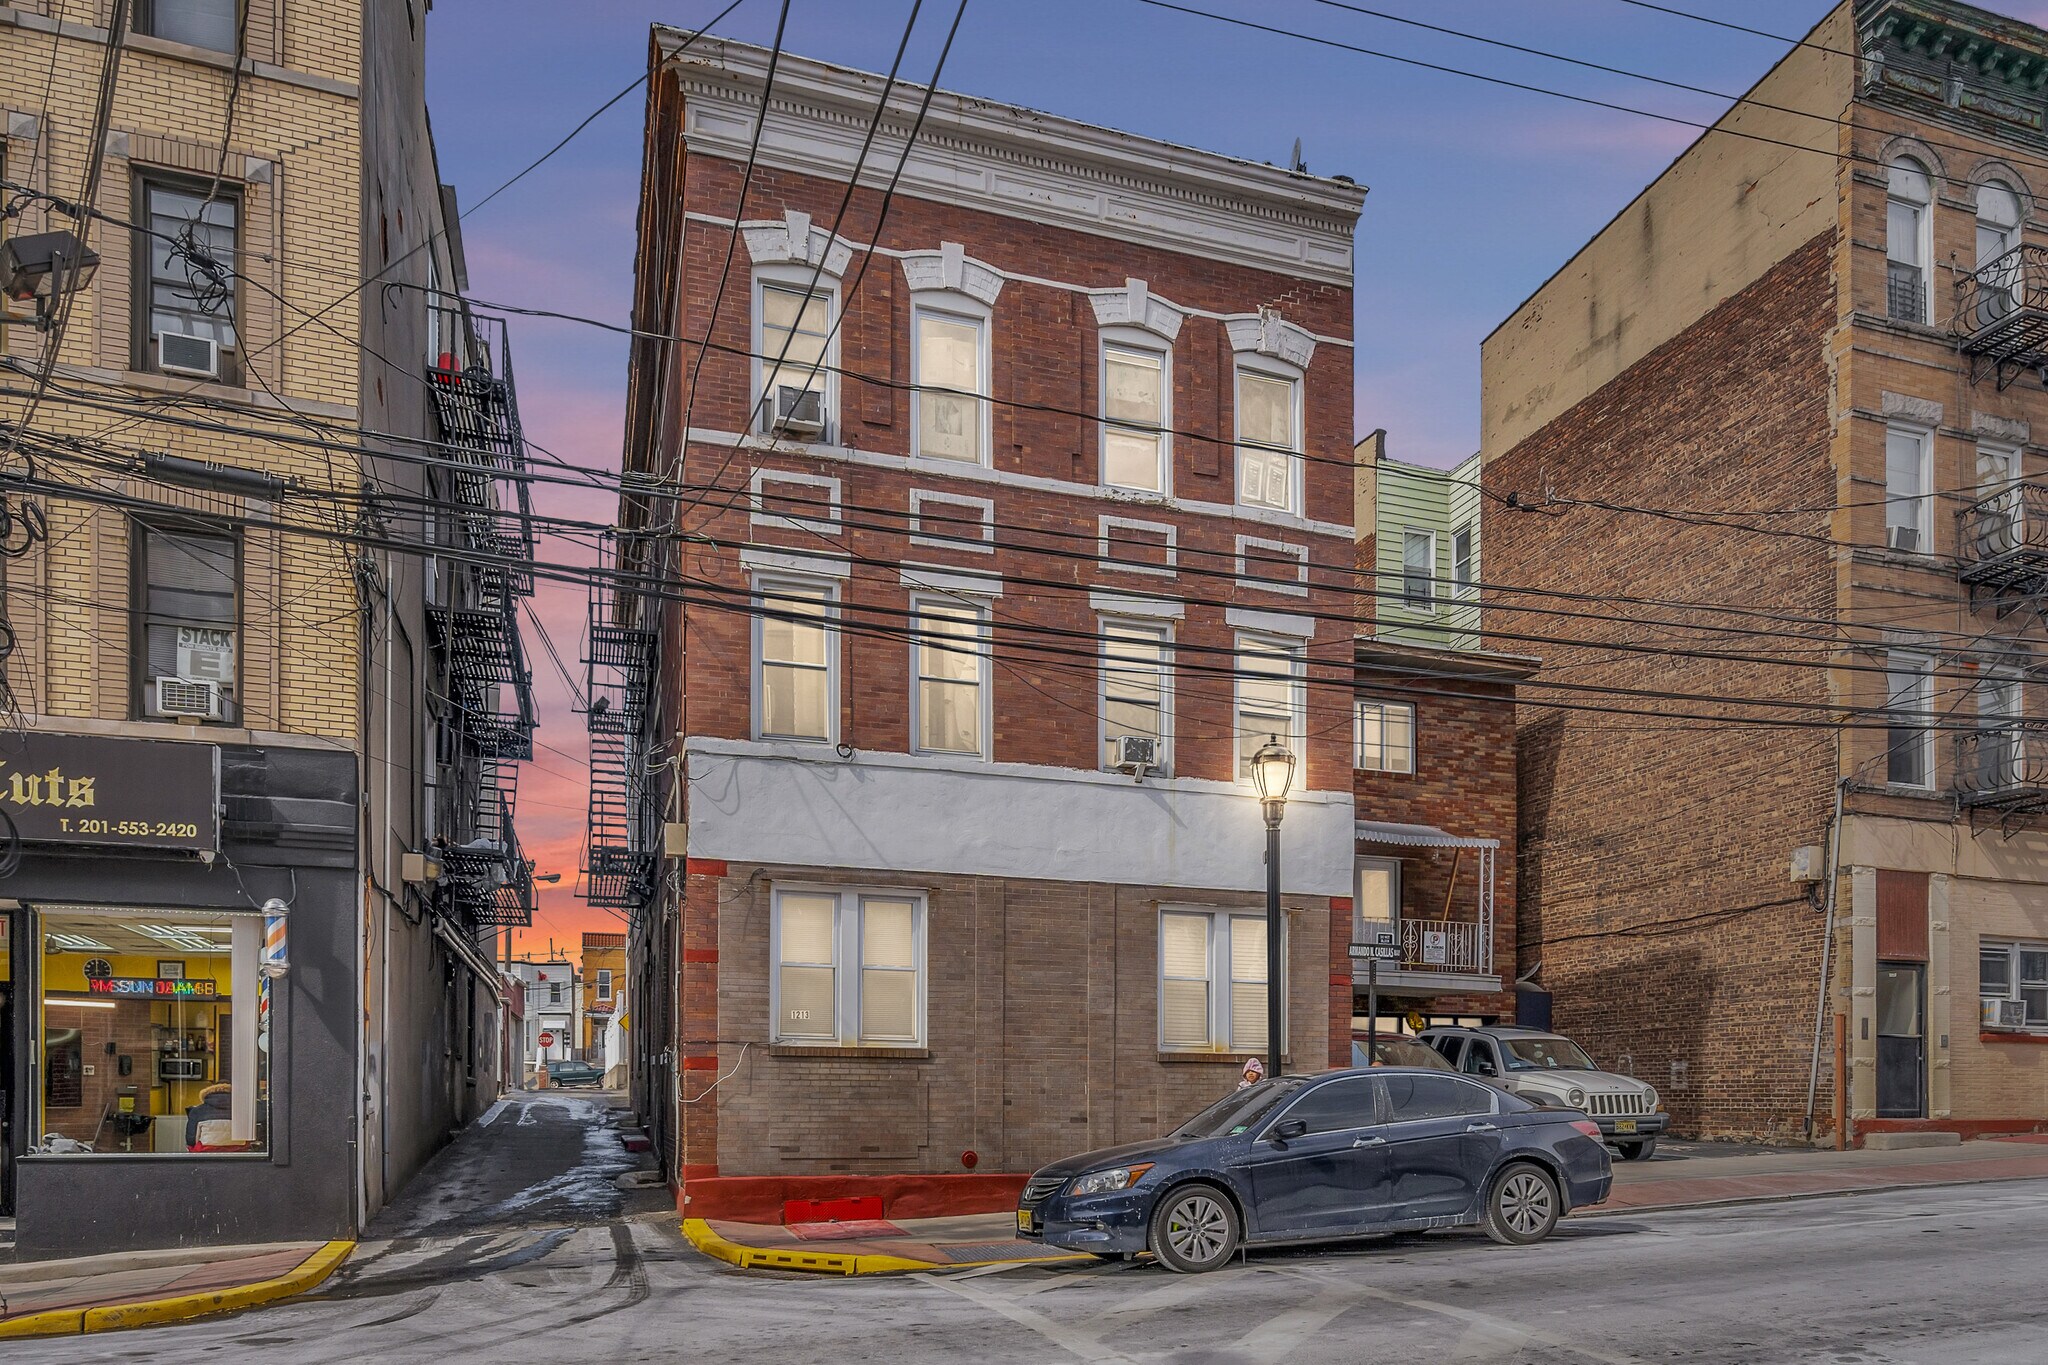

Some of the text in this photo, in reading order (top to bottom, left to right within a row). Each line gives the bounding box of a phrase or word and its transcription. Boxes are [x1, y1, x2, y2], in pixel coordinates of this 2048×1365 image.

[181, 627, 231, 647] STACK
[60, 818, 197, 838] T. 201-553-2420
[793, 1011, 809, 1019] 1213
[539, 1036, 553, 1044] STOP
